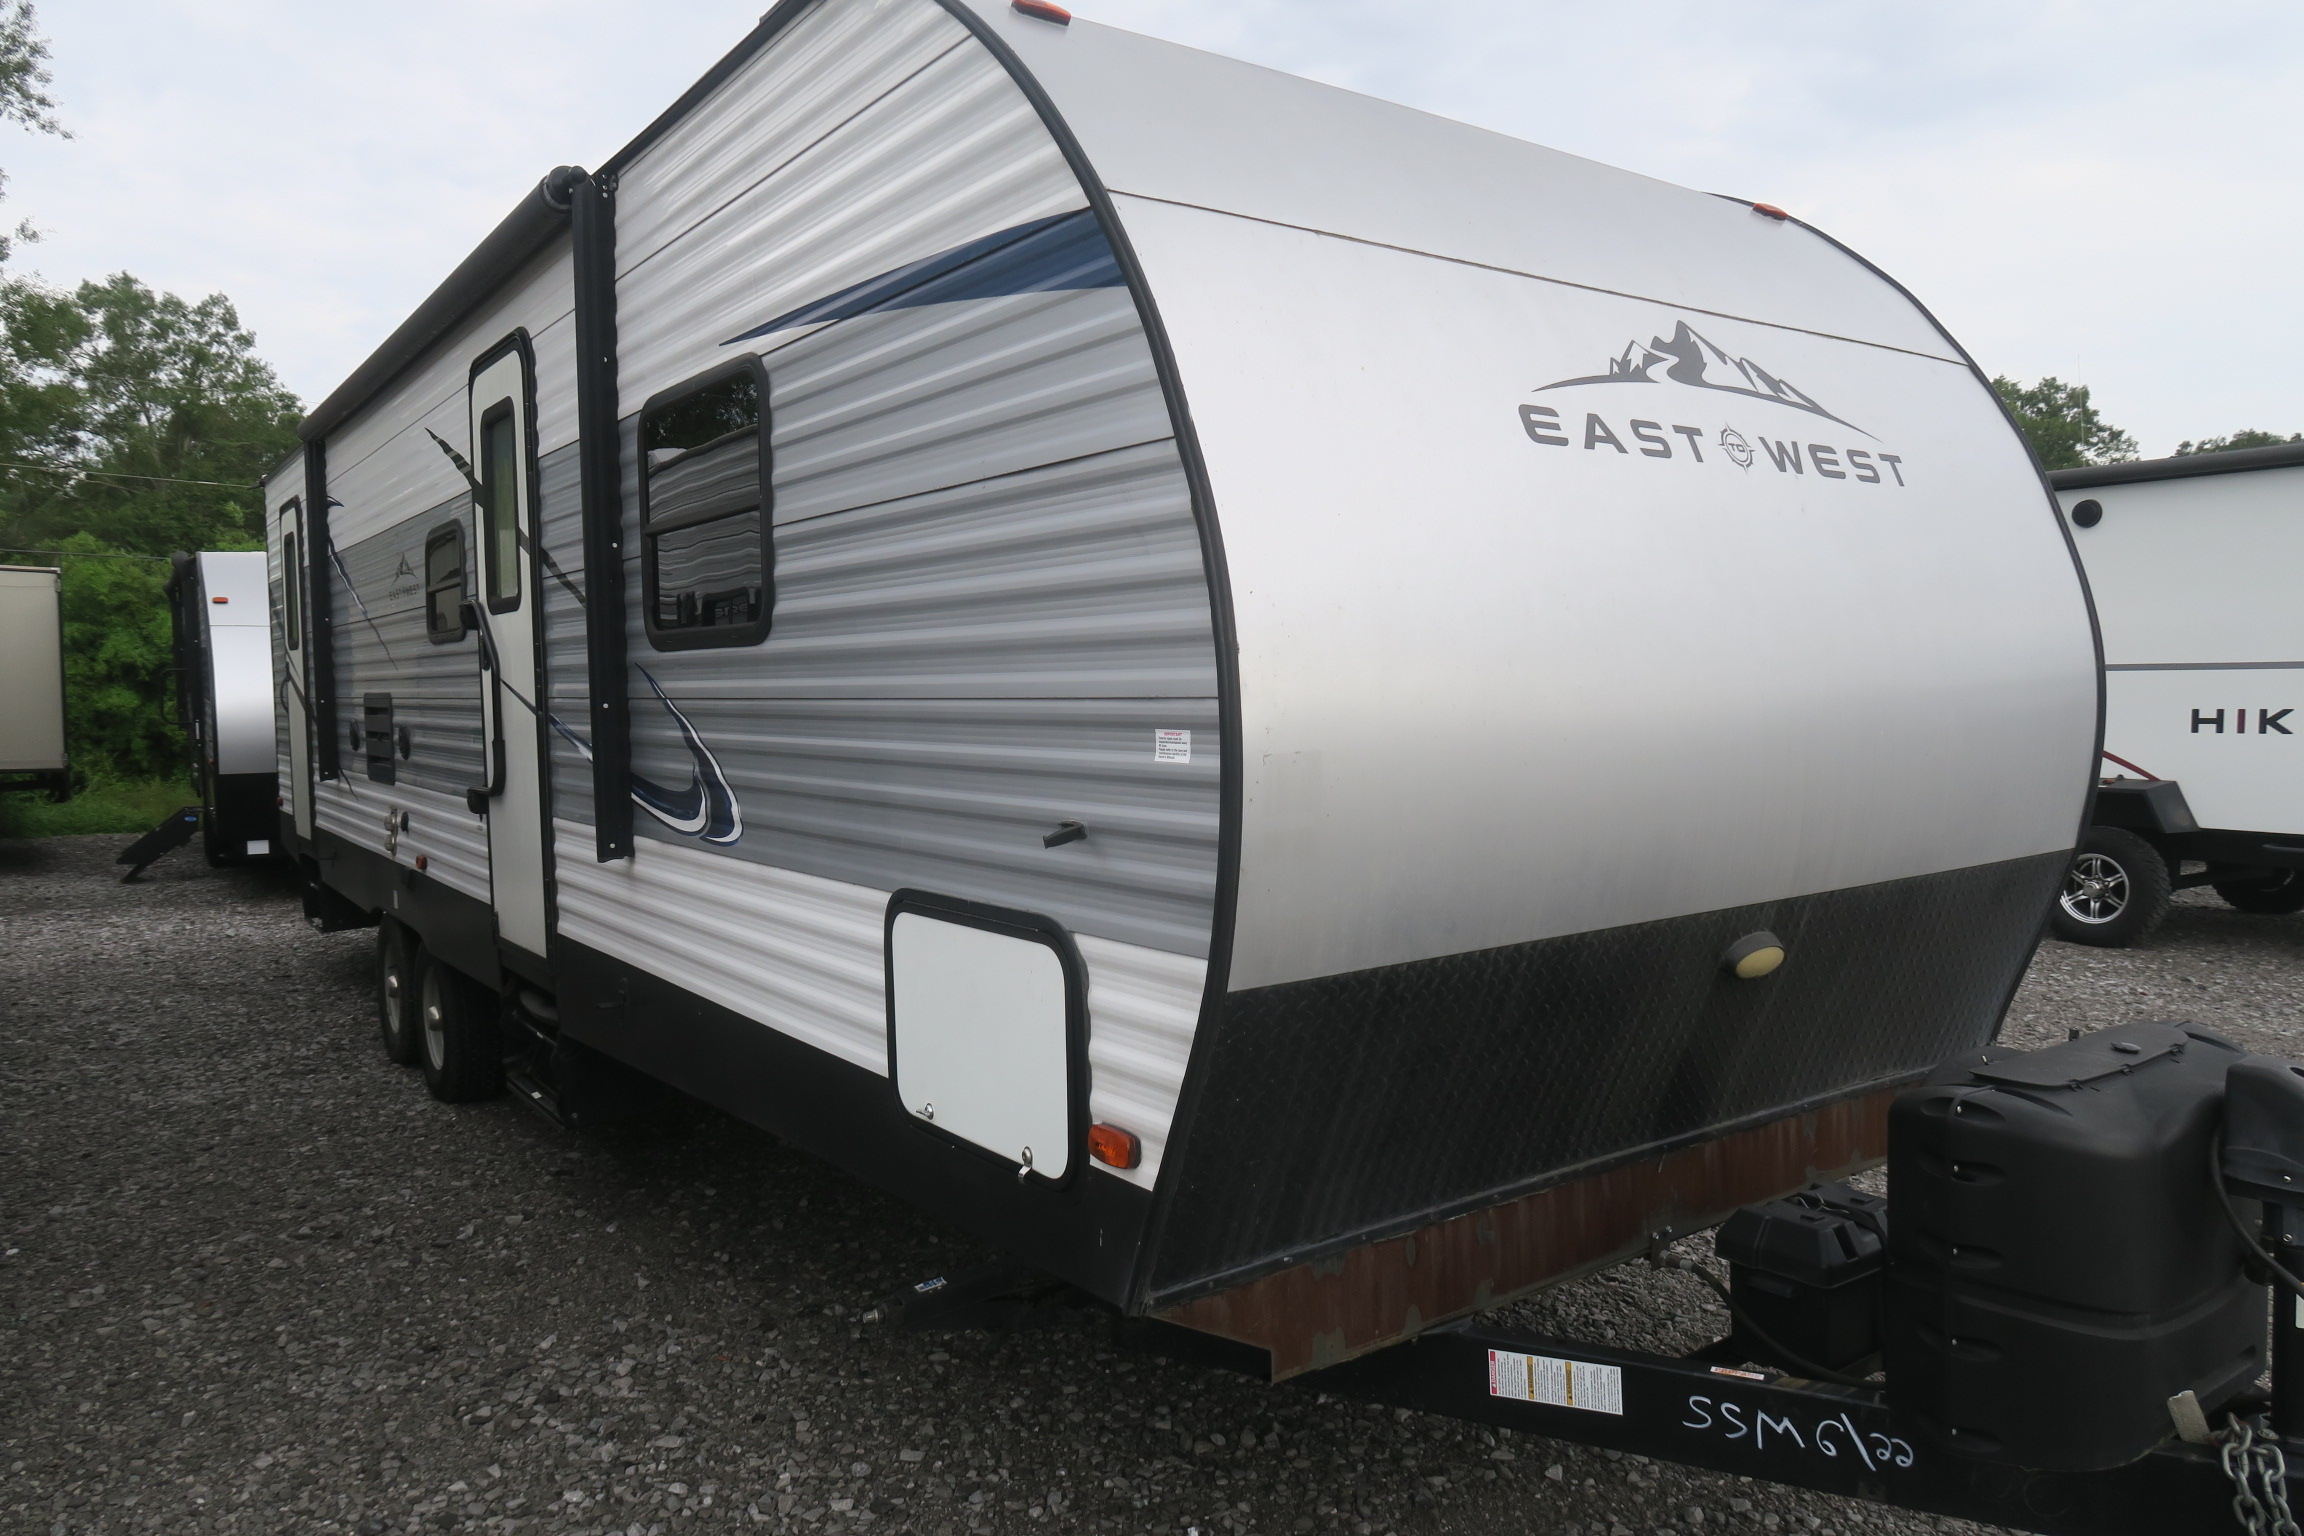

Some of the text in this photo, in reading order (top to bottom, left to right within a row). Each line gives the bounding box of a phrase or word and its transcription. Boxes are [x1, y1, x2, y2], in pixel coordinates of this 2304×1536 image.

[1519, 404, 1704, 463] EAST
[1758, 436, 1905, 487] WEST
[1682, 1395, 1806, 1450] SSM
